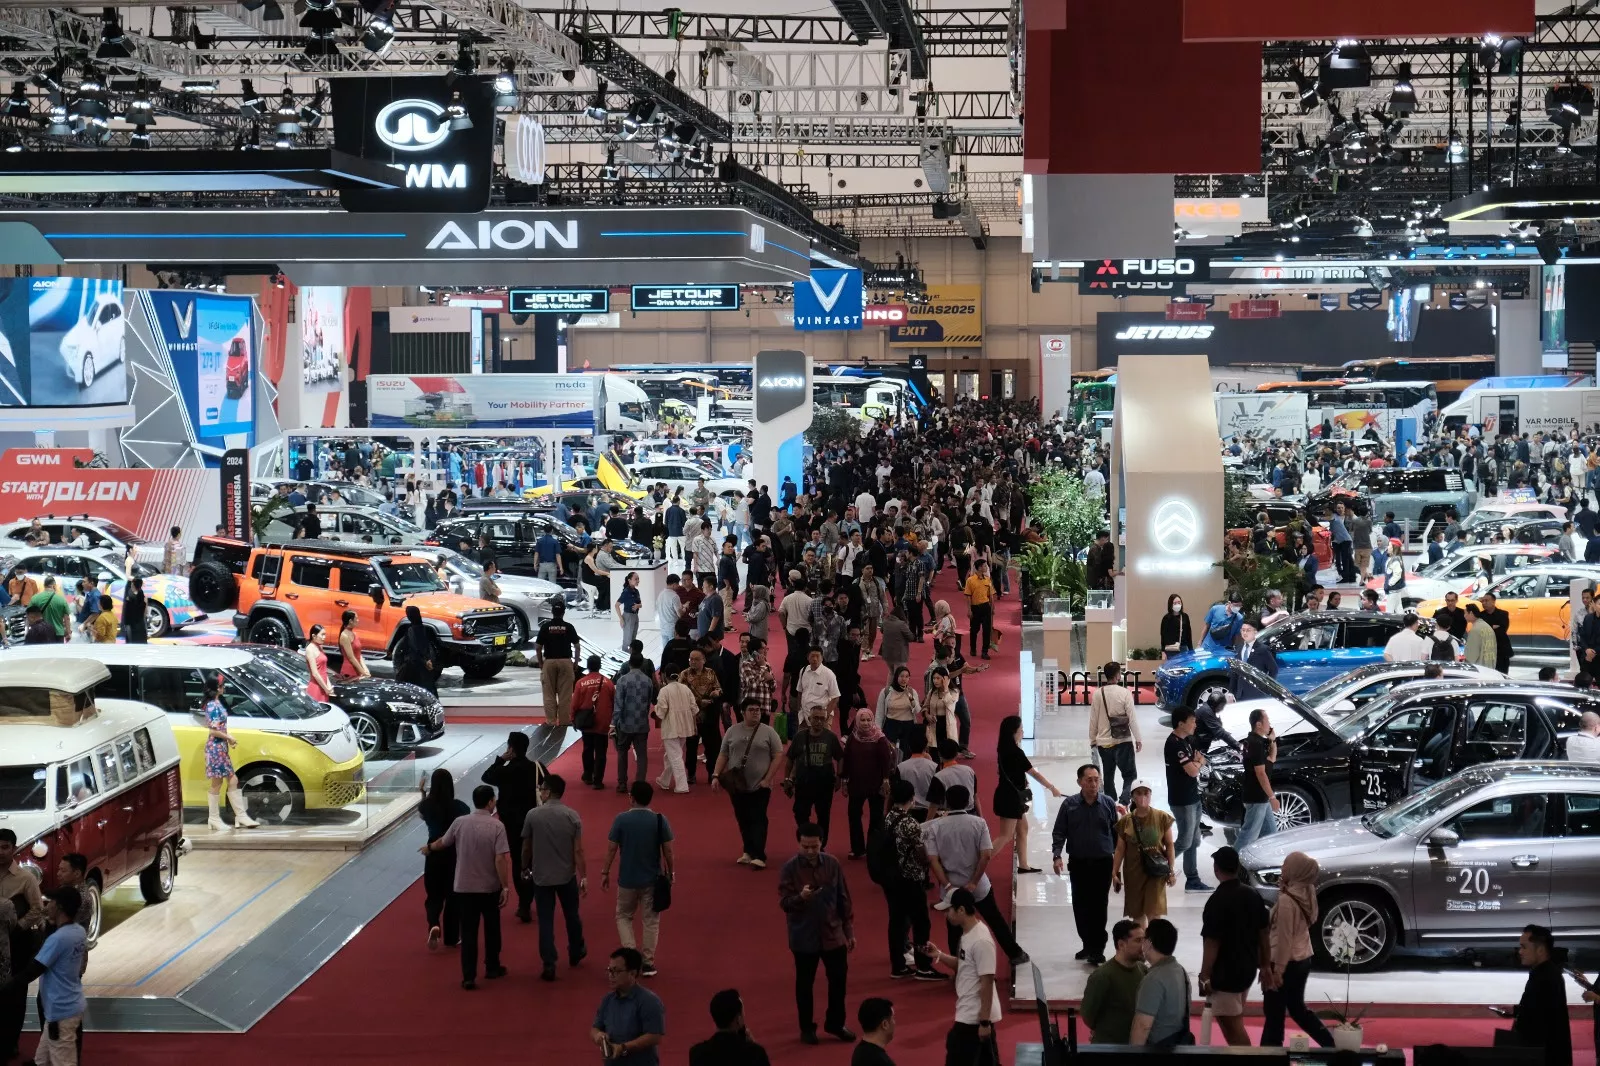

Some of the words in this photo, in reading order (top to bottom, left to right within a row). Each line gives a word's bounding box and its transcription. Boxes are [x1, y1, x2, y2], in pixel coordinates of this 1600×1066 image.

[388, 163, 467, 188] WM
[425, 220, 578, 249] AION
[1122, 259, 1195, 275] FUSO
[524, 293, 593, 302] JETOUR
[648, 289, 722, 298] JETOUR
[906, 305, 976, 315] GIIAS2025
[797, 316, 859, 325] VINFAST
[898, 326, 928, 336] EXIT
[1115, 325, 1216, 340] JETBUS
[759, 378, 803, 387] AION
[488, 401, 508, 409] Your
[510, 401, 547, 410] Mobility
[549, 401, 585, 409] Partner
[16, 454, 61, 465] GWM
[226, 456, 243, 466] 2024
[1, 481, 49, 493] START
[26, 493, 44, 501] WITH
[42, 481, 140, 508] JOLION
[233, 474, 242, 525] INDONESIA
[227, 482, 236, 538] ASSEMBLED
[235, 527, 243, 538] IN
[1366, 773, 1381, 796] 23
[1459, 868, 1490, 895] 20
